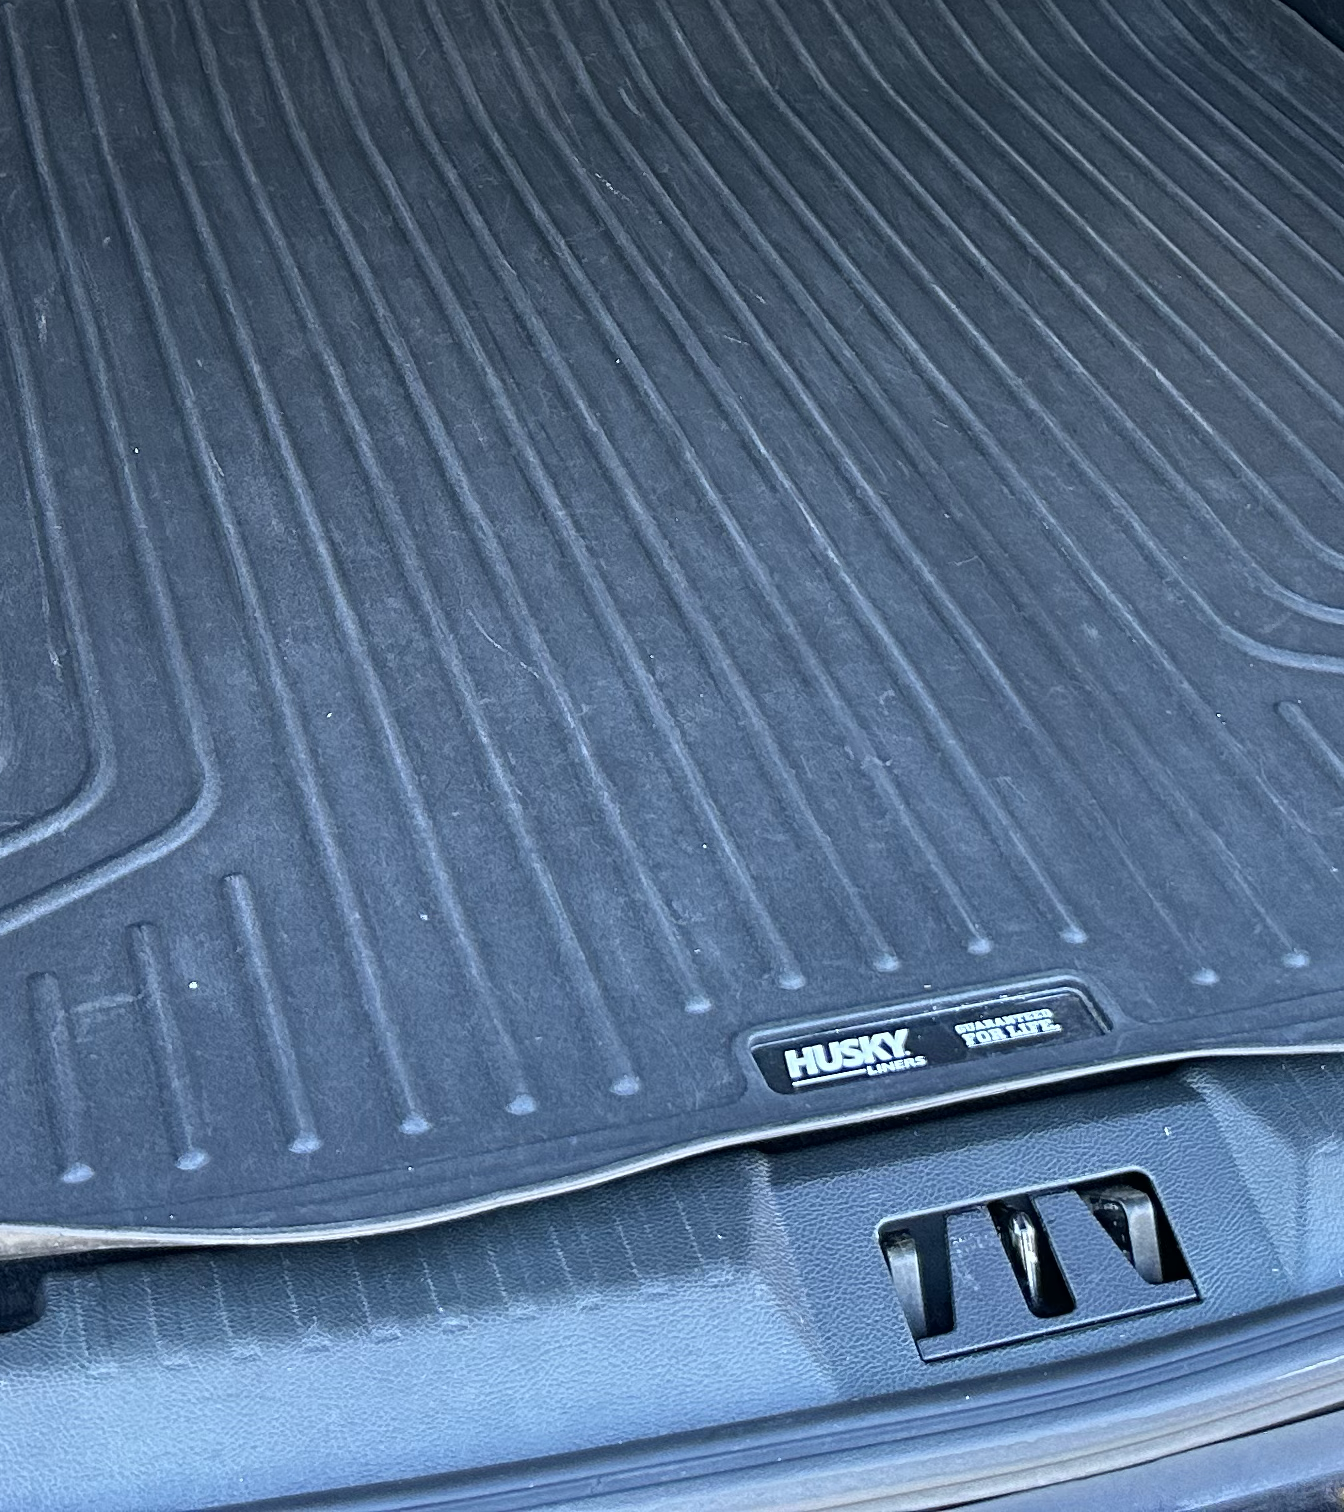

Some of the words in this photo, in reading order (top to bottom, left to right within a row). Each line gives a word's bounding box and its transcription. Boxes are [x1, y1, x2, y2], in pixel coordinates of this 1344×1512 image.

[954, 1008, 1054, 1035] GUARANTEED
[961, 1027, 1008, 1048] FOR
[867, 1055, 928, 1076] LINERS
